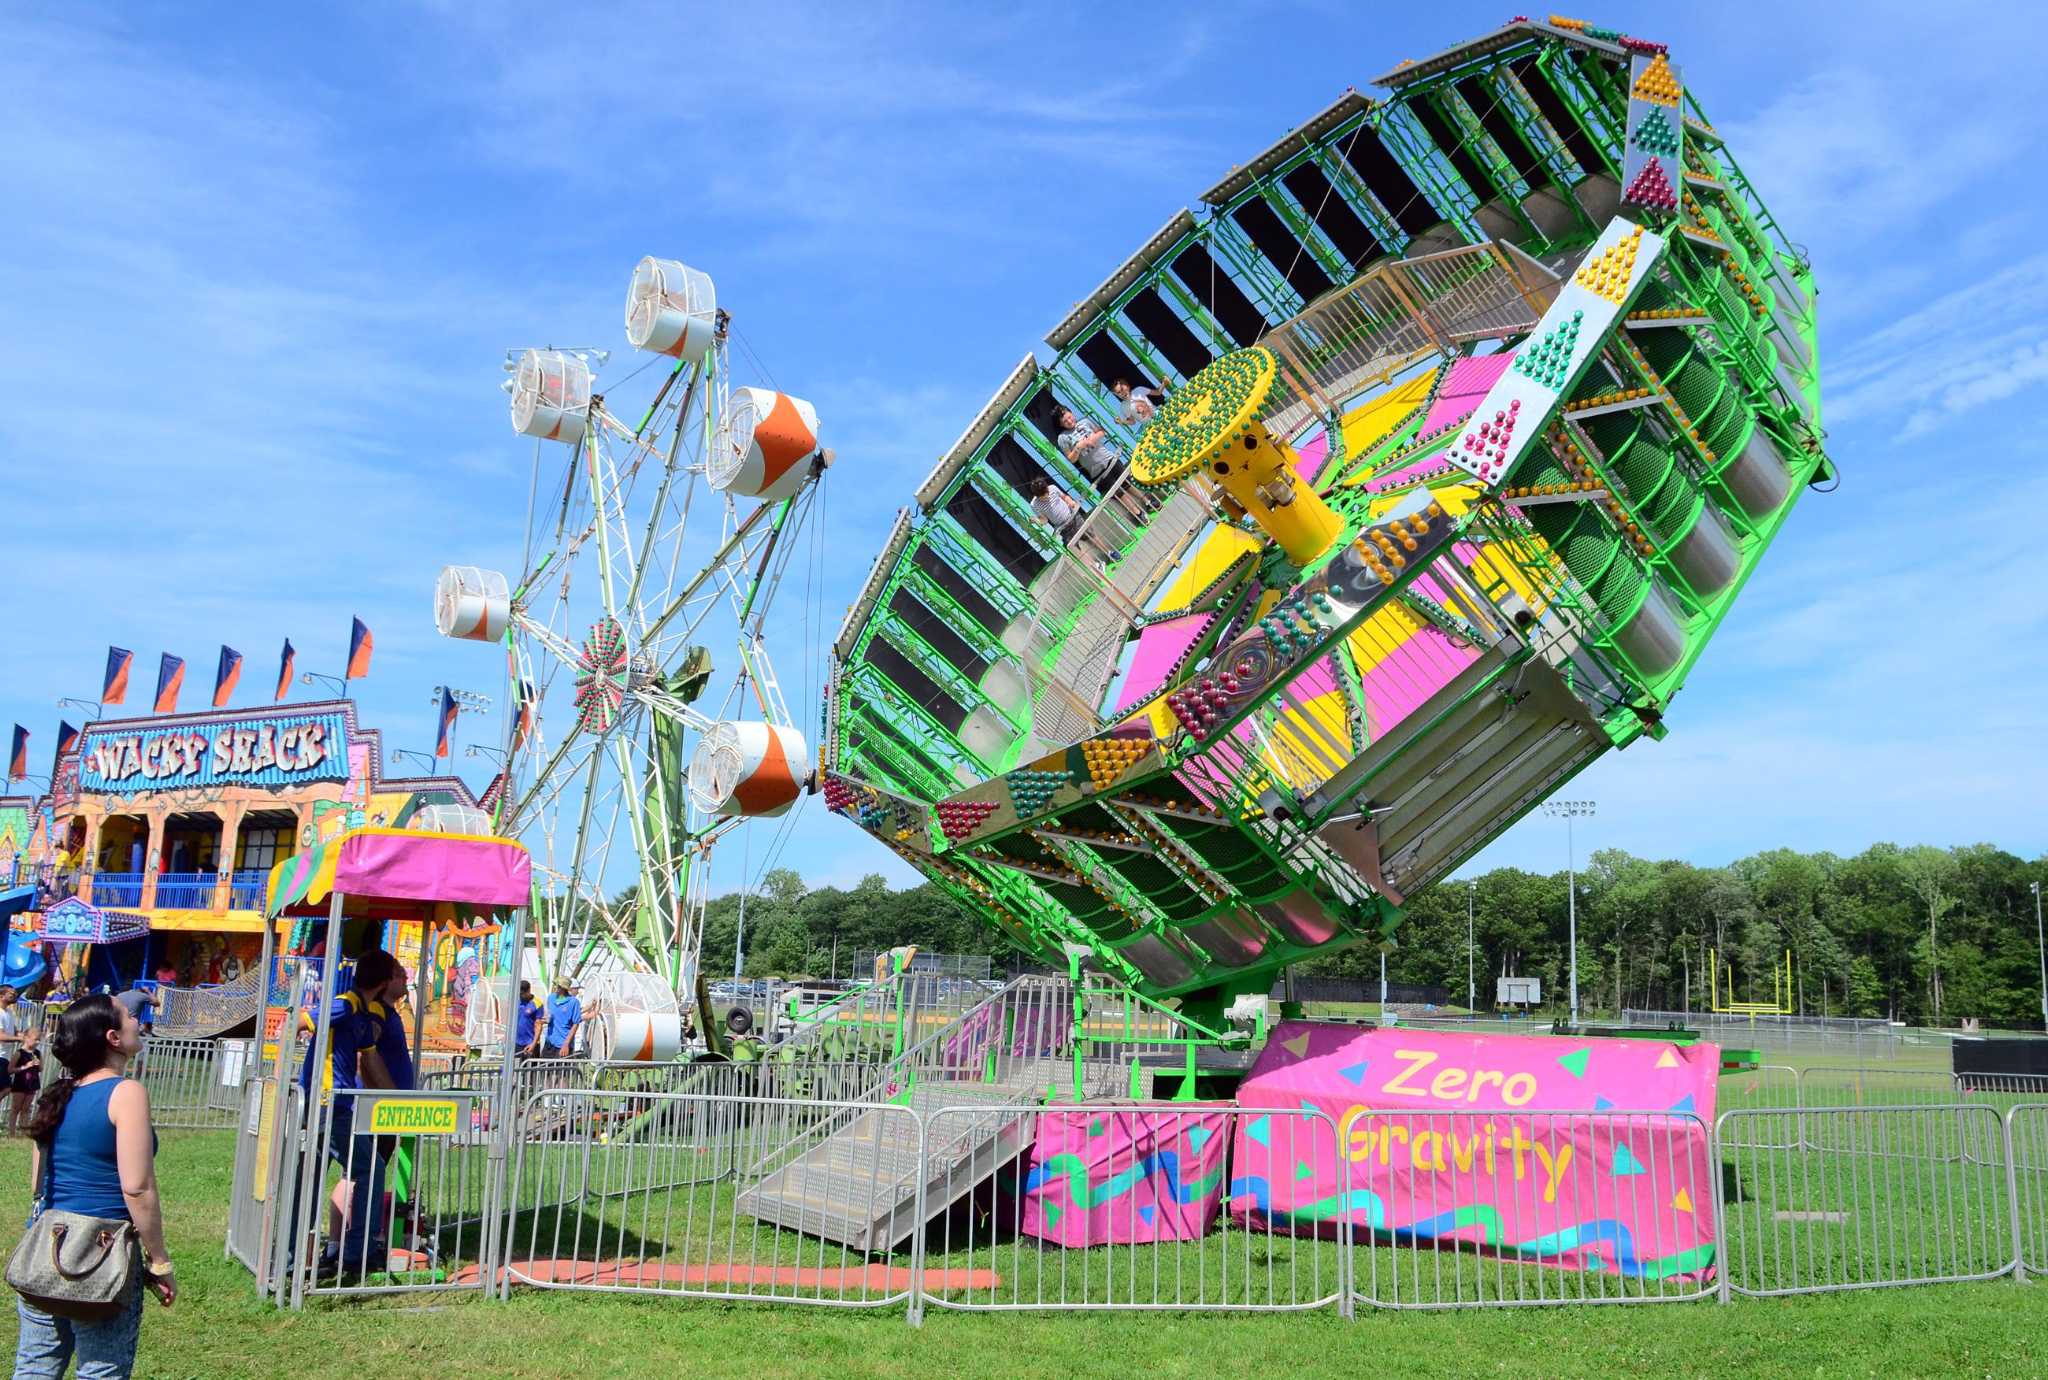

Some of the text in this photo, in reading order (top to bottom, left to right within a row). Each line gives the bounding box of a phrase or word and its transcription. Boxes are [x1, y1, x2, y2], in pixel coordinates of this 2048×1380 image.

[94, 721, 326, 782] WACKY SHACK
[1381, 1049, 1537, 1106] Zero
[376, 1104, 452, 1127] ENTRANCE
[1338, 1104, 1573, 1203] Gravity
